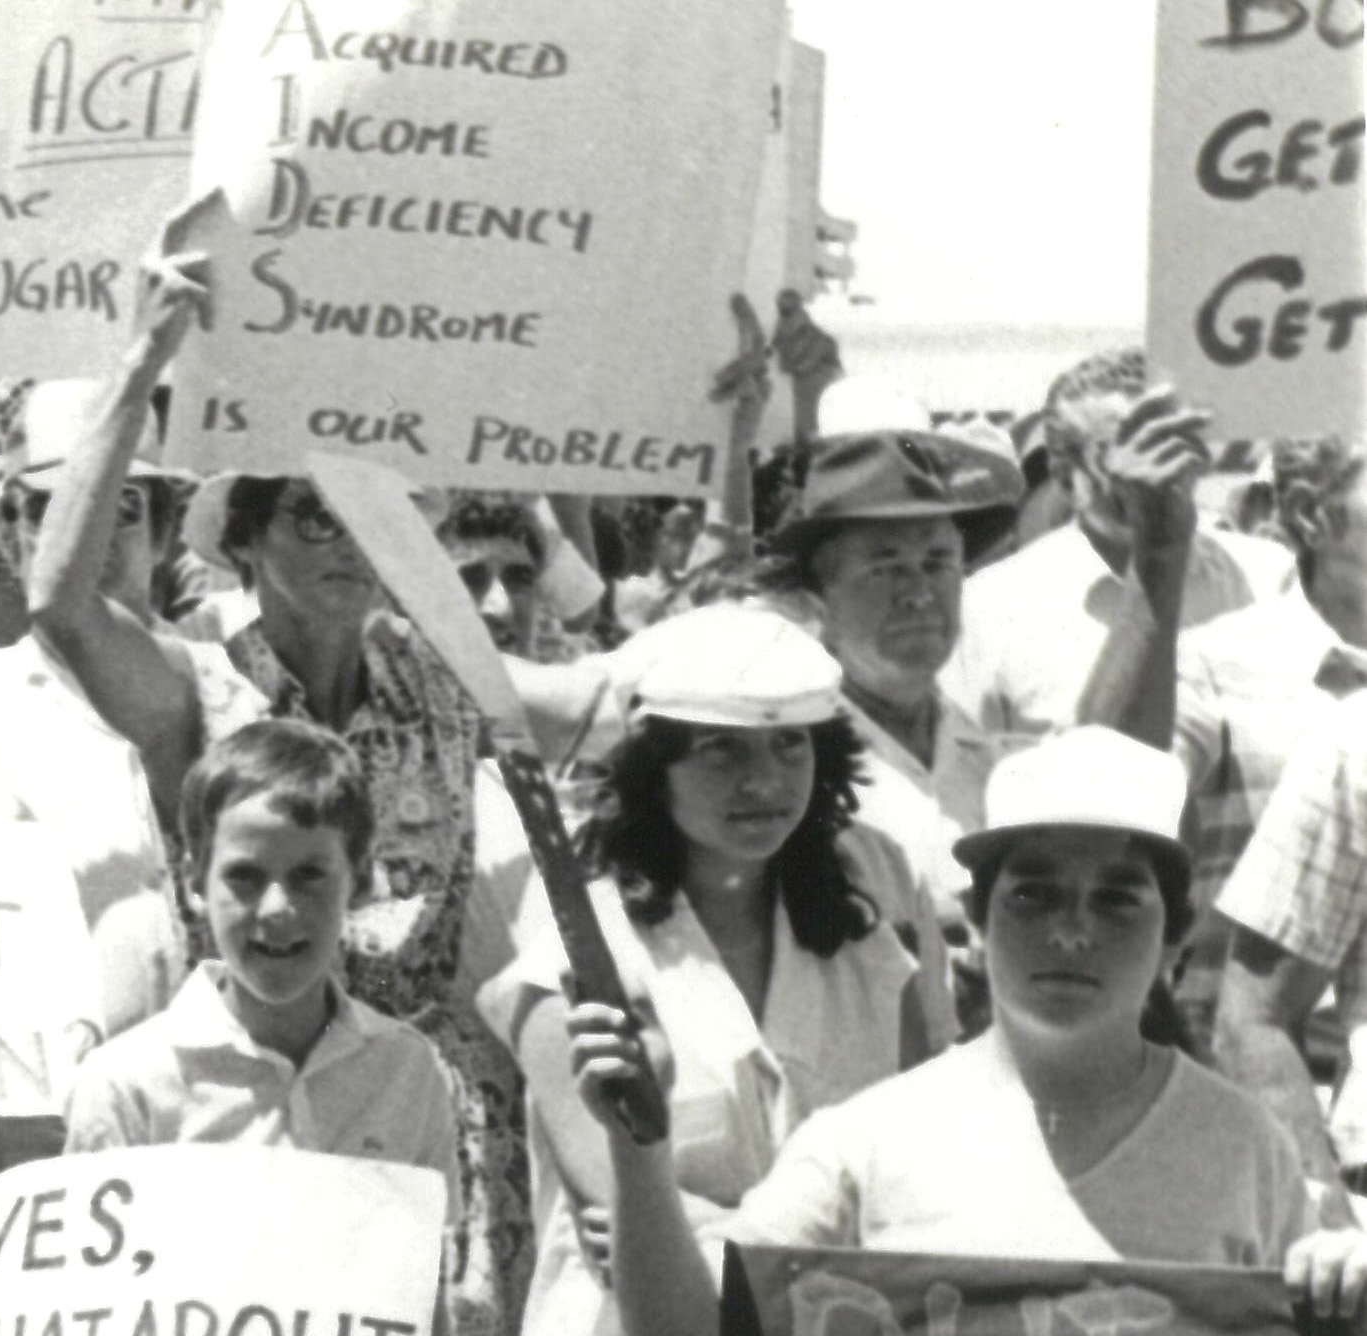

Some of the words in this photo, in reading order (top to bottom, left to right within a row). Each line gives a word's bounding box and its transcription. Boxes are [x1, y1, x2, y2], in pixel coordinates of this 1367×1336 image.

[260, 0, 569, 80] ACQUIRED
[268, 73, 494, 160] INCOME
[253, 159, 593, 254] DEFICIENCY
[243, 248, 541, 349] SYNDROME
[202, 397, 249, 434] IS
[308, 406, 427, 457] OUR
[466, 421, 718, 487] PROBLEM
